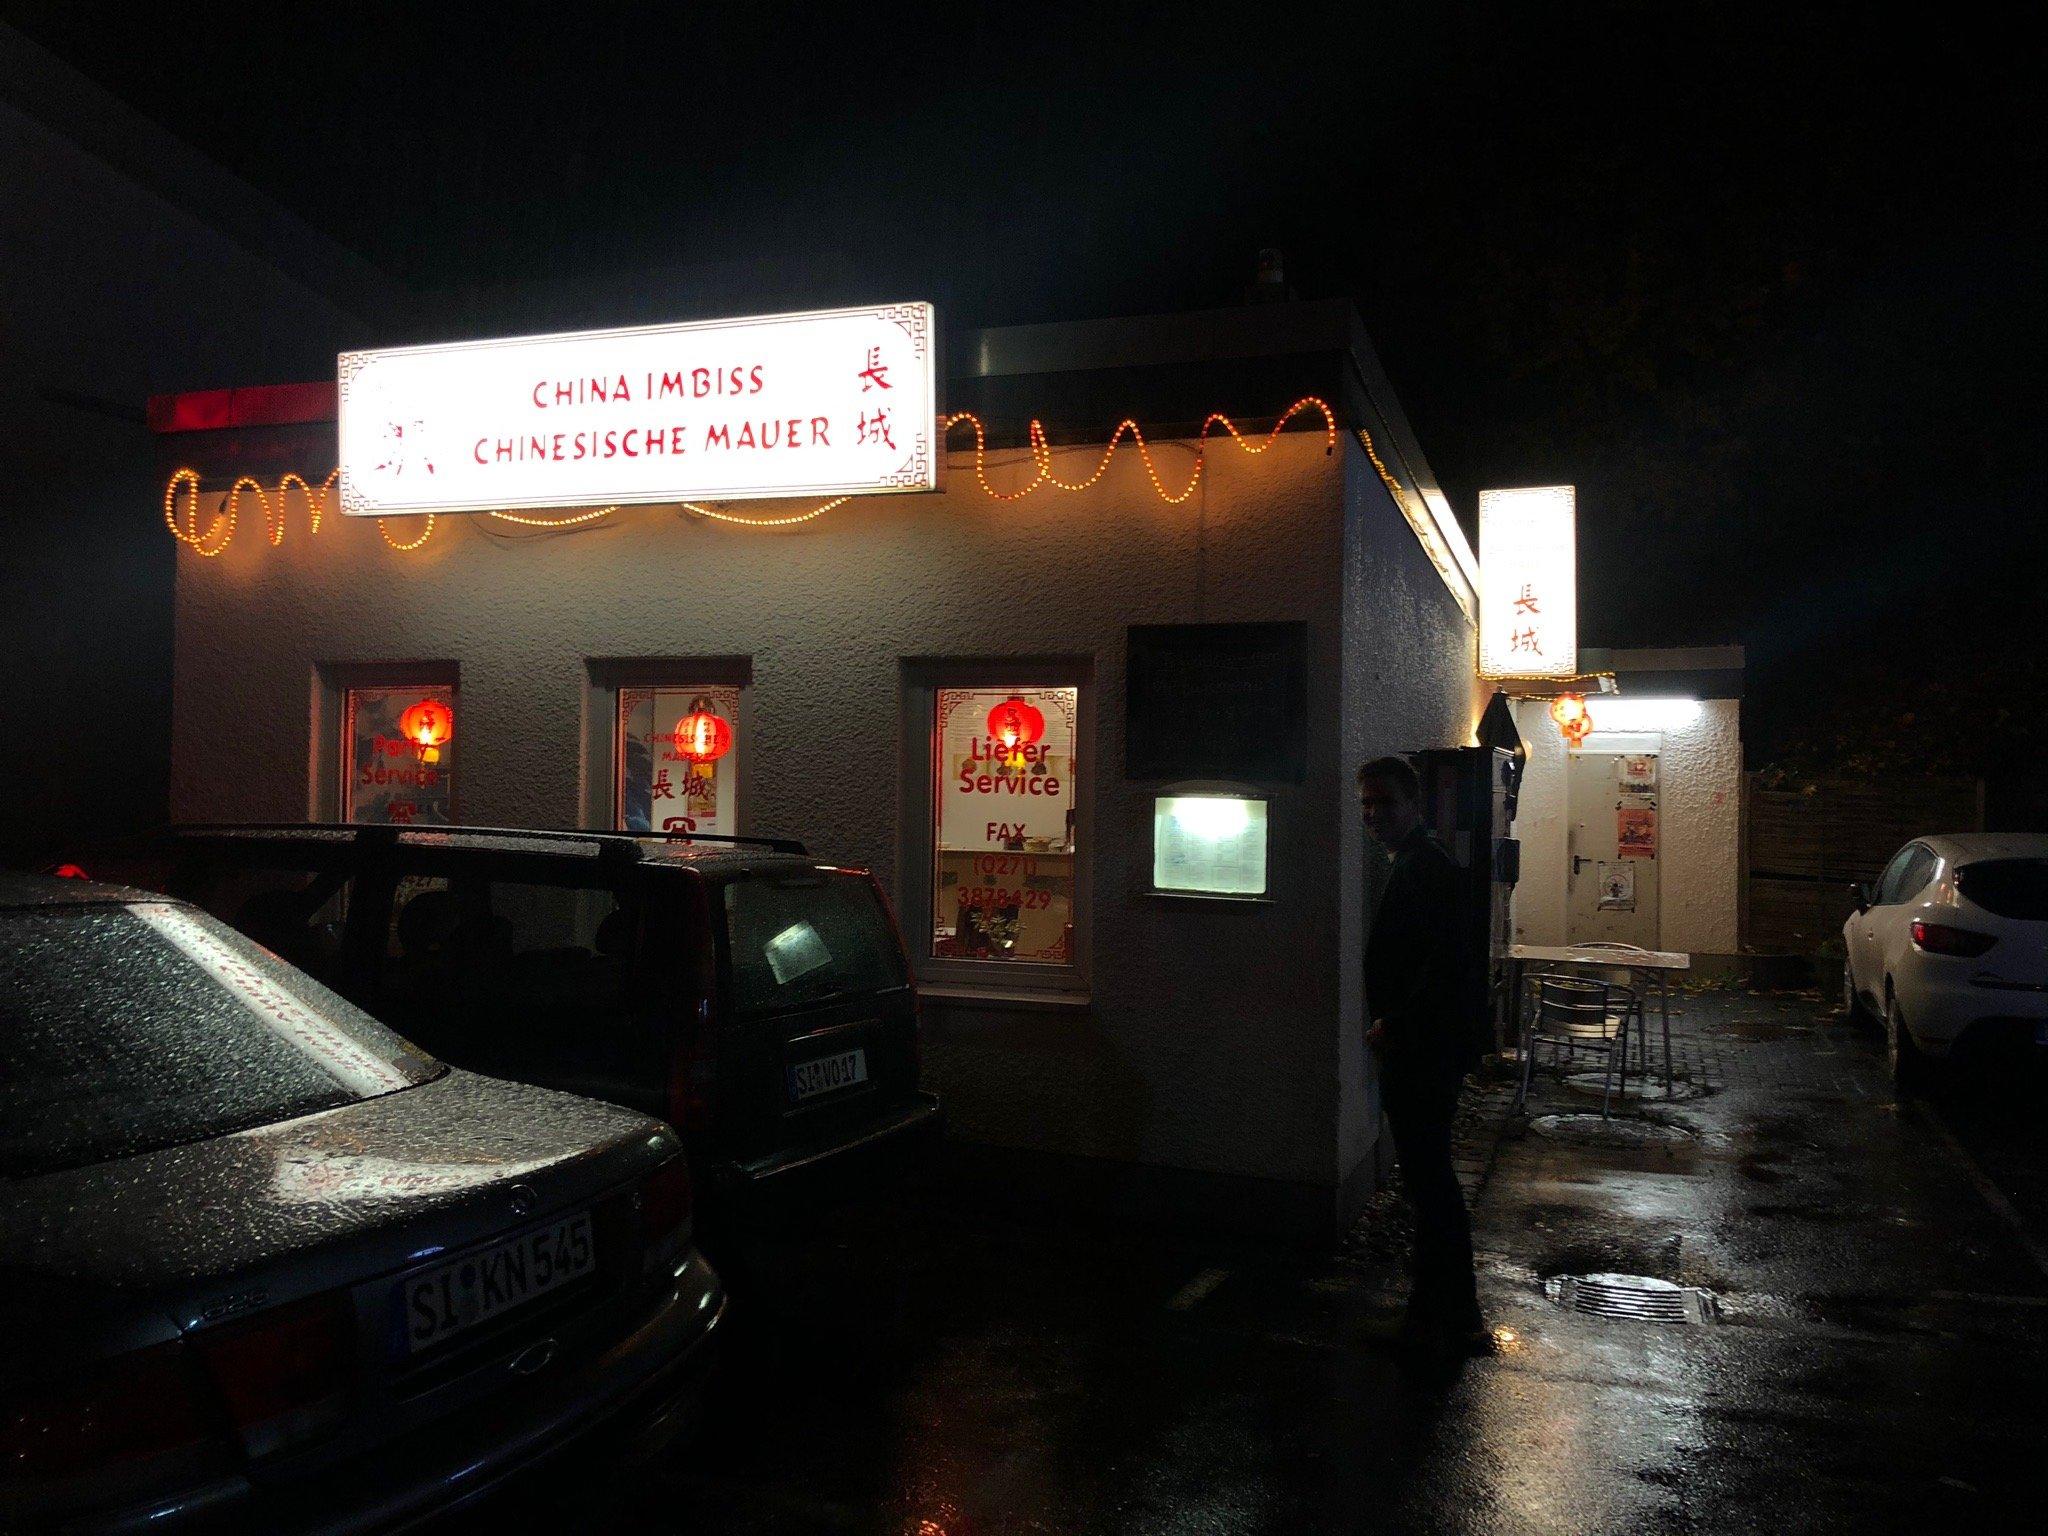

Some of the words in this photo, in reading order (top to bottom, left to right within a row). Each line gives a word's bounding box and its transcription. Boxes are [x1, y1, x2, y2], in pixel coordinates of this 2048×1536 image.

[533, 375, 632, 410] CHINA
[647, 364, 765, 400] IMBISS
[856, 345, 897, 451] 長城
[473, 426, 687, 466] CHINESISCHE
[704, 416, 833, 452] MAUER
[1511, 583, 1543, 657] 長城
[971, 736, 1051, 763] Liefer
[362, 762, 438, 787] Service
[652, 768, 709, 800] 長城
[958, 768, 1060, 796] Service
[987, 821, 1025, 843] FAX
[972, 854, 1037, 876] (0271)
[411, 1273, 458, 1340] SI
[479, 1243, 528, 1310] KN
[532, 1219, 589, 1287] 545
